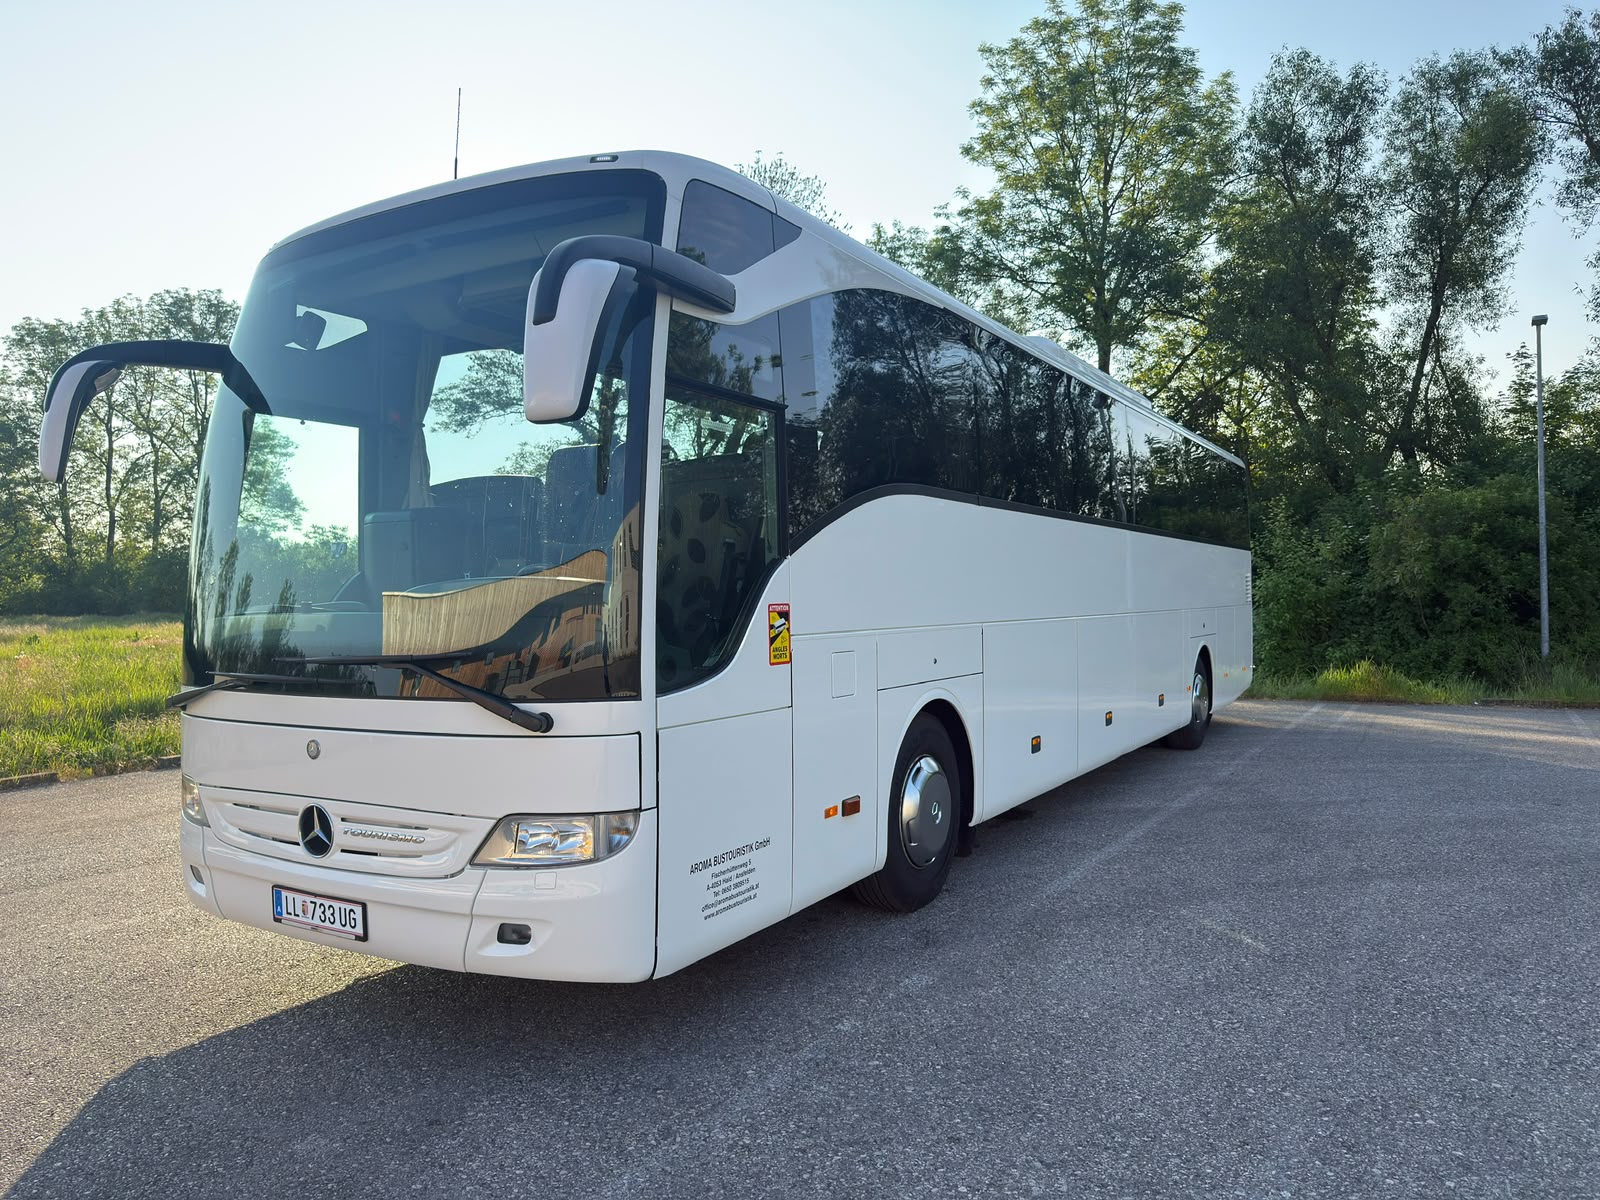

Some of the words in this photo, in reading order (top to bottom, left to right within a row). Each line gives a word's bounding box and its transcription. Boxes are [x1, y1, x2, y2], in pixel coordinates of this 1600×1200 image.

[343, 827, 425, 844] TOURISMO
[689, 858, 713, 875] AROMA
[713, 842, 755, 867] BUSTOURISTIK
[754, 836, 771, 851] GmbH
[722, 875, 733, 884] Haid
[735, 867, 756, 879] Ansfelden
[276, 905, 282, 913] A
[701, 882, 760, 912] office@aromabustouristik.at
[703, 893, 758, 921] www.aromabustouristik.at
[285, 895, 300, 918] LL
[309, 900, 336, 925] 733
[339, 906, 357, 929] UG
